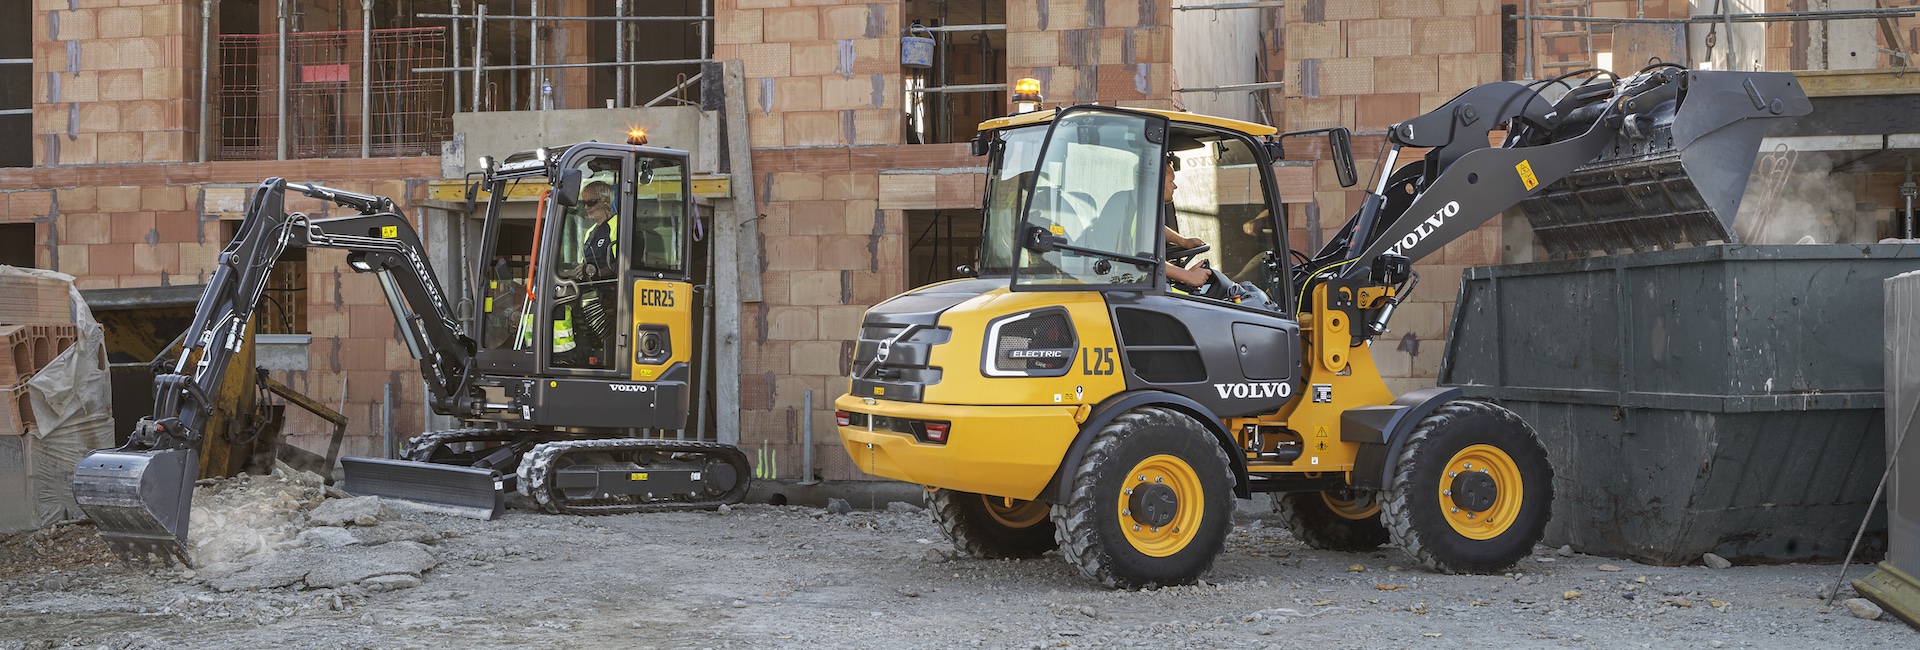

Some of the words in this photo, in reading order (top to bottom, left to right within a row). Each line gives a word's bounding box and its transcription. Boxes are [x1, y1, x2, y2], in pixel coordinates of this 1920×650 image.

[1382, 200, 1460, 256] VOLVO
[641, 288, 675, 308] ECR25
[1013, 350, 1062, 358] ELECTRIC
[1082, 347, 1115, 376] L25
[609, 384, 648, 392] VOLVO
[1213, 382, 1291, 399] VOLVO
